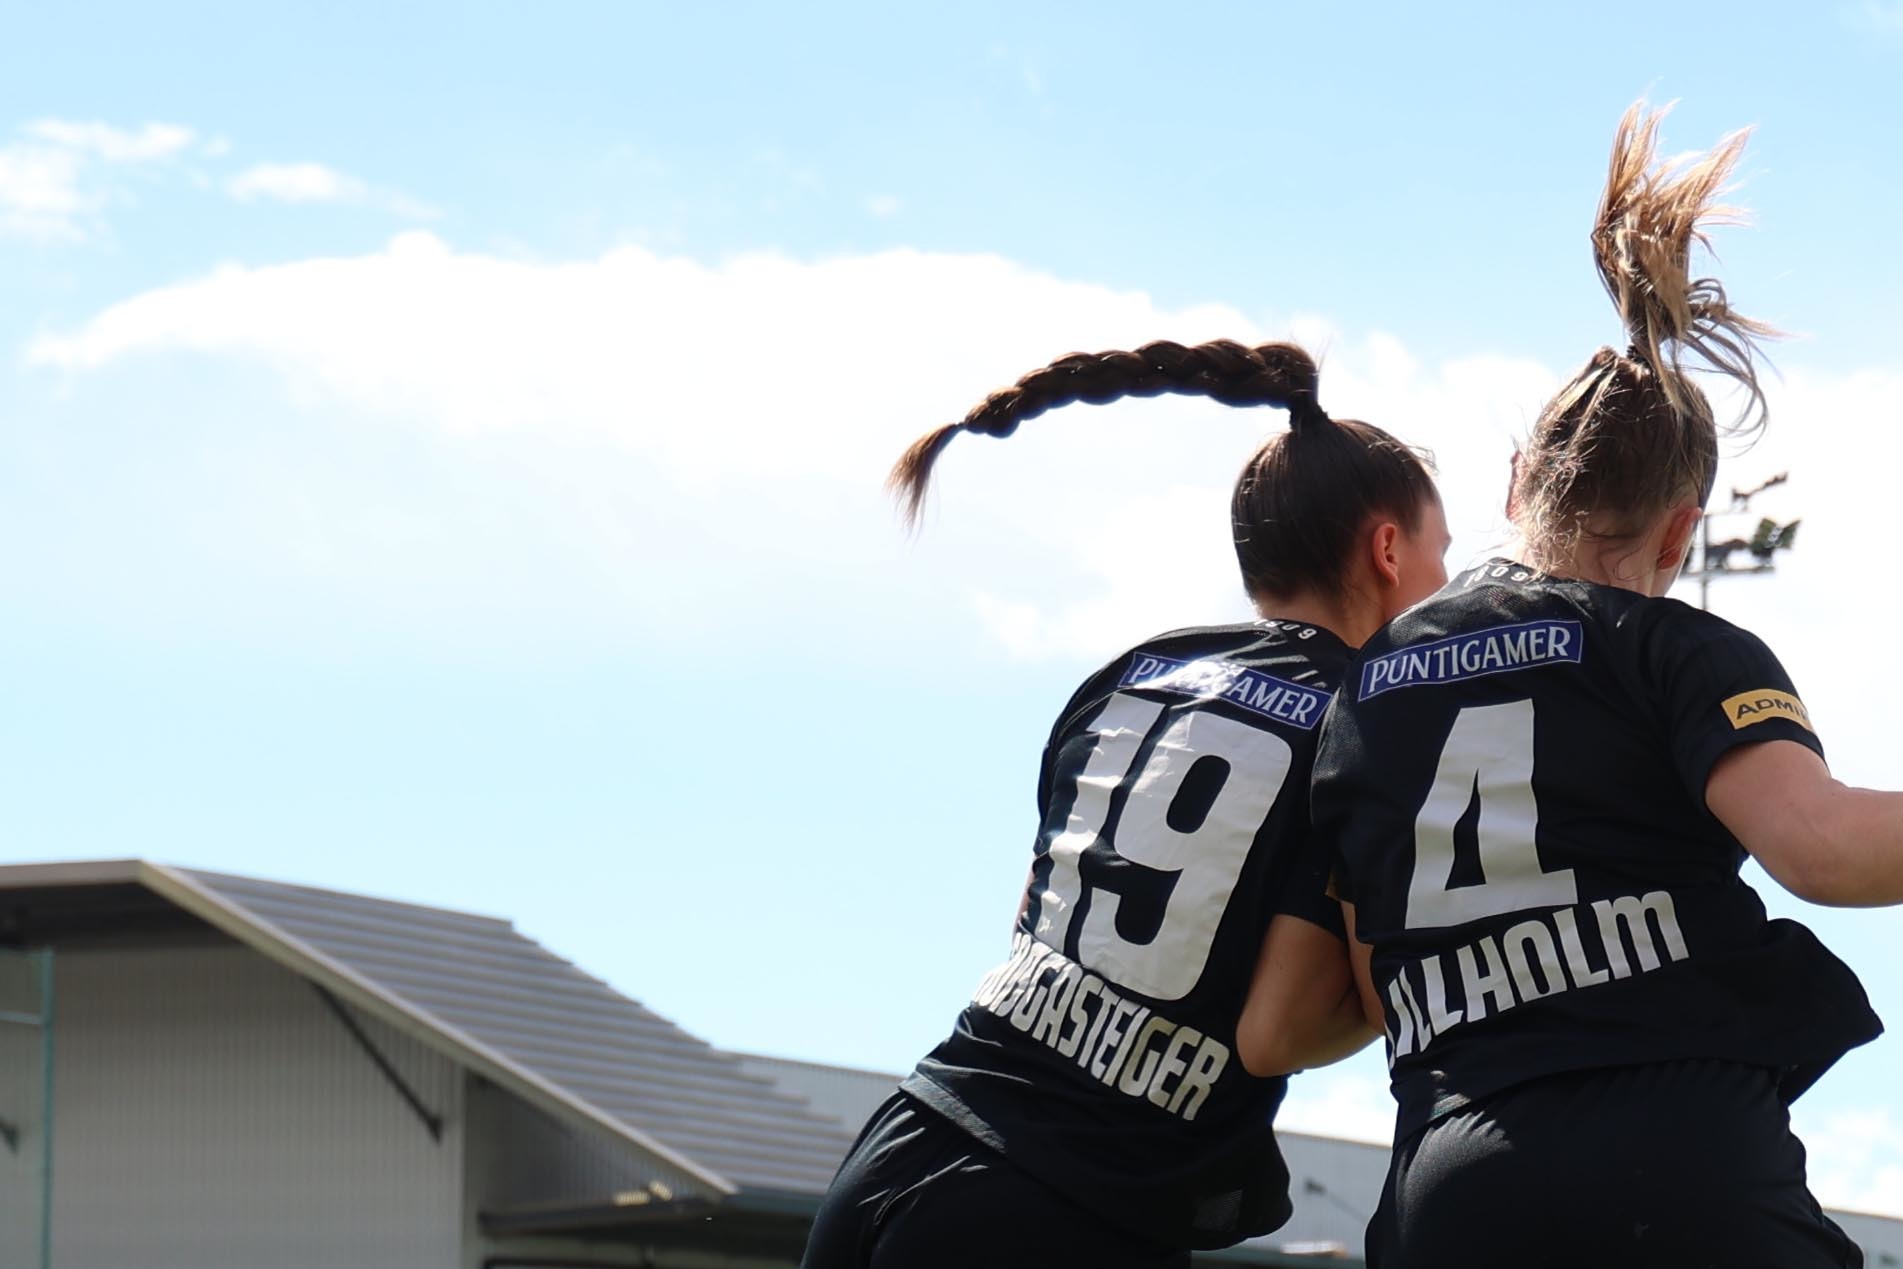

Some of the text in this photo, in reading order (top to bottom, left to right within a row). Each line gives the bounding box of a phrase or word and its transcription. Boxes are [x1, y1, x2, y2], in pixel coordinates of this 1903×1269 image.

[1367, 626, 1571, 693] PUNTIGAMER
[1034, 692, 1293, 998] 19
[1404, 698, 1578, 930] 4
